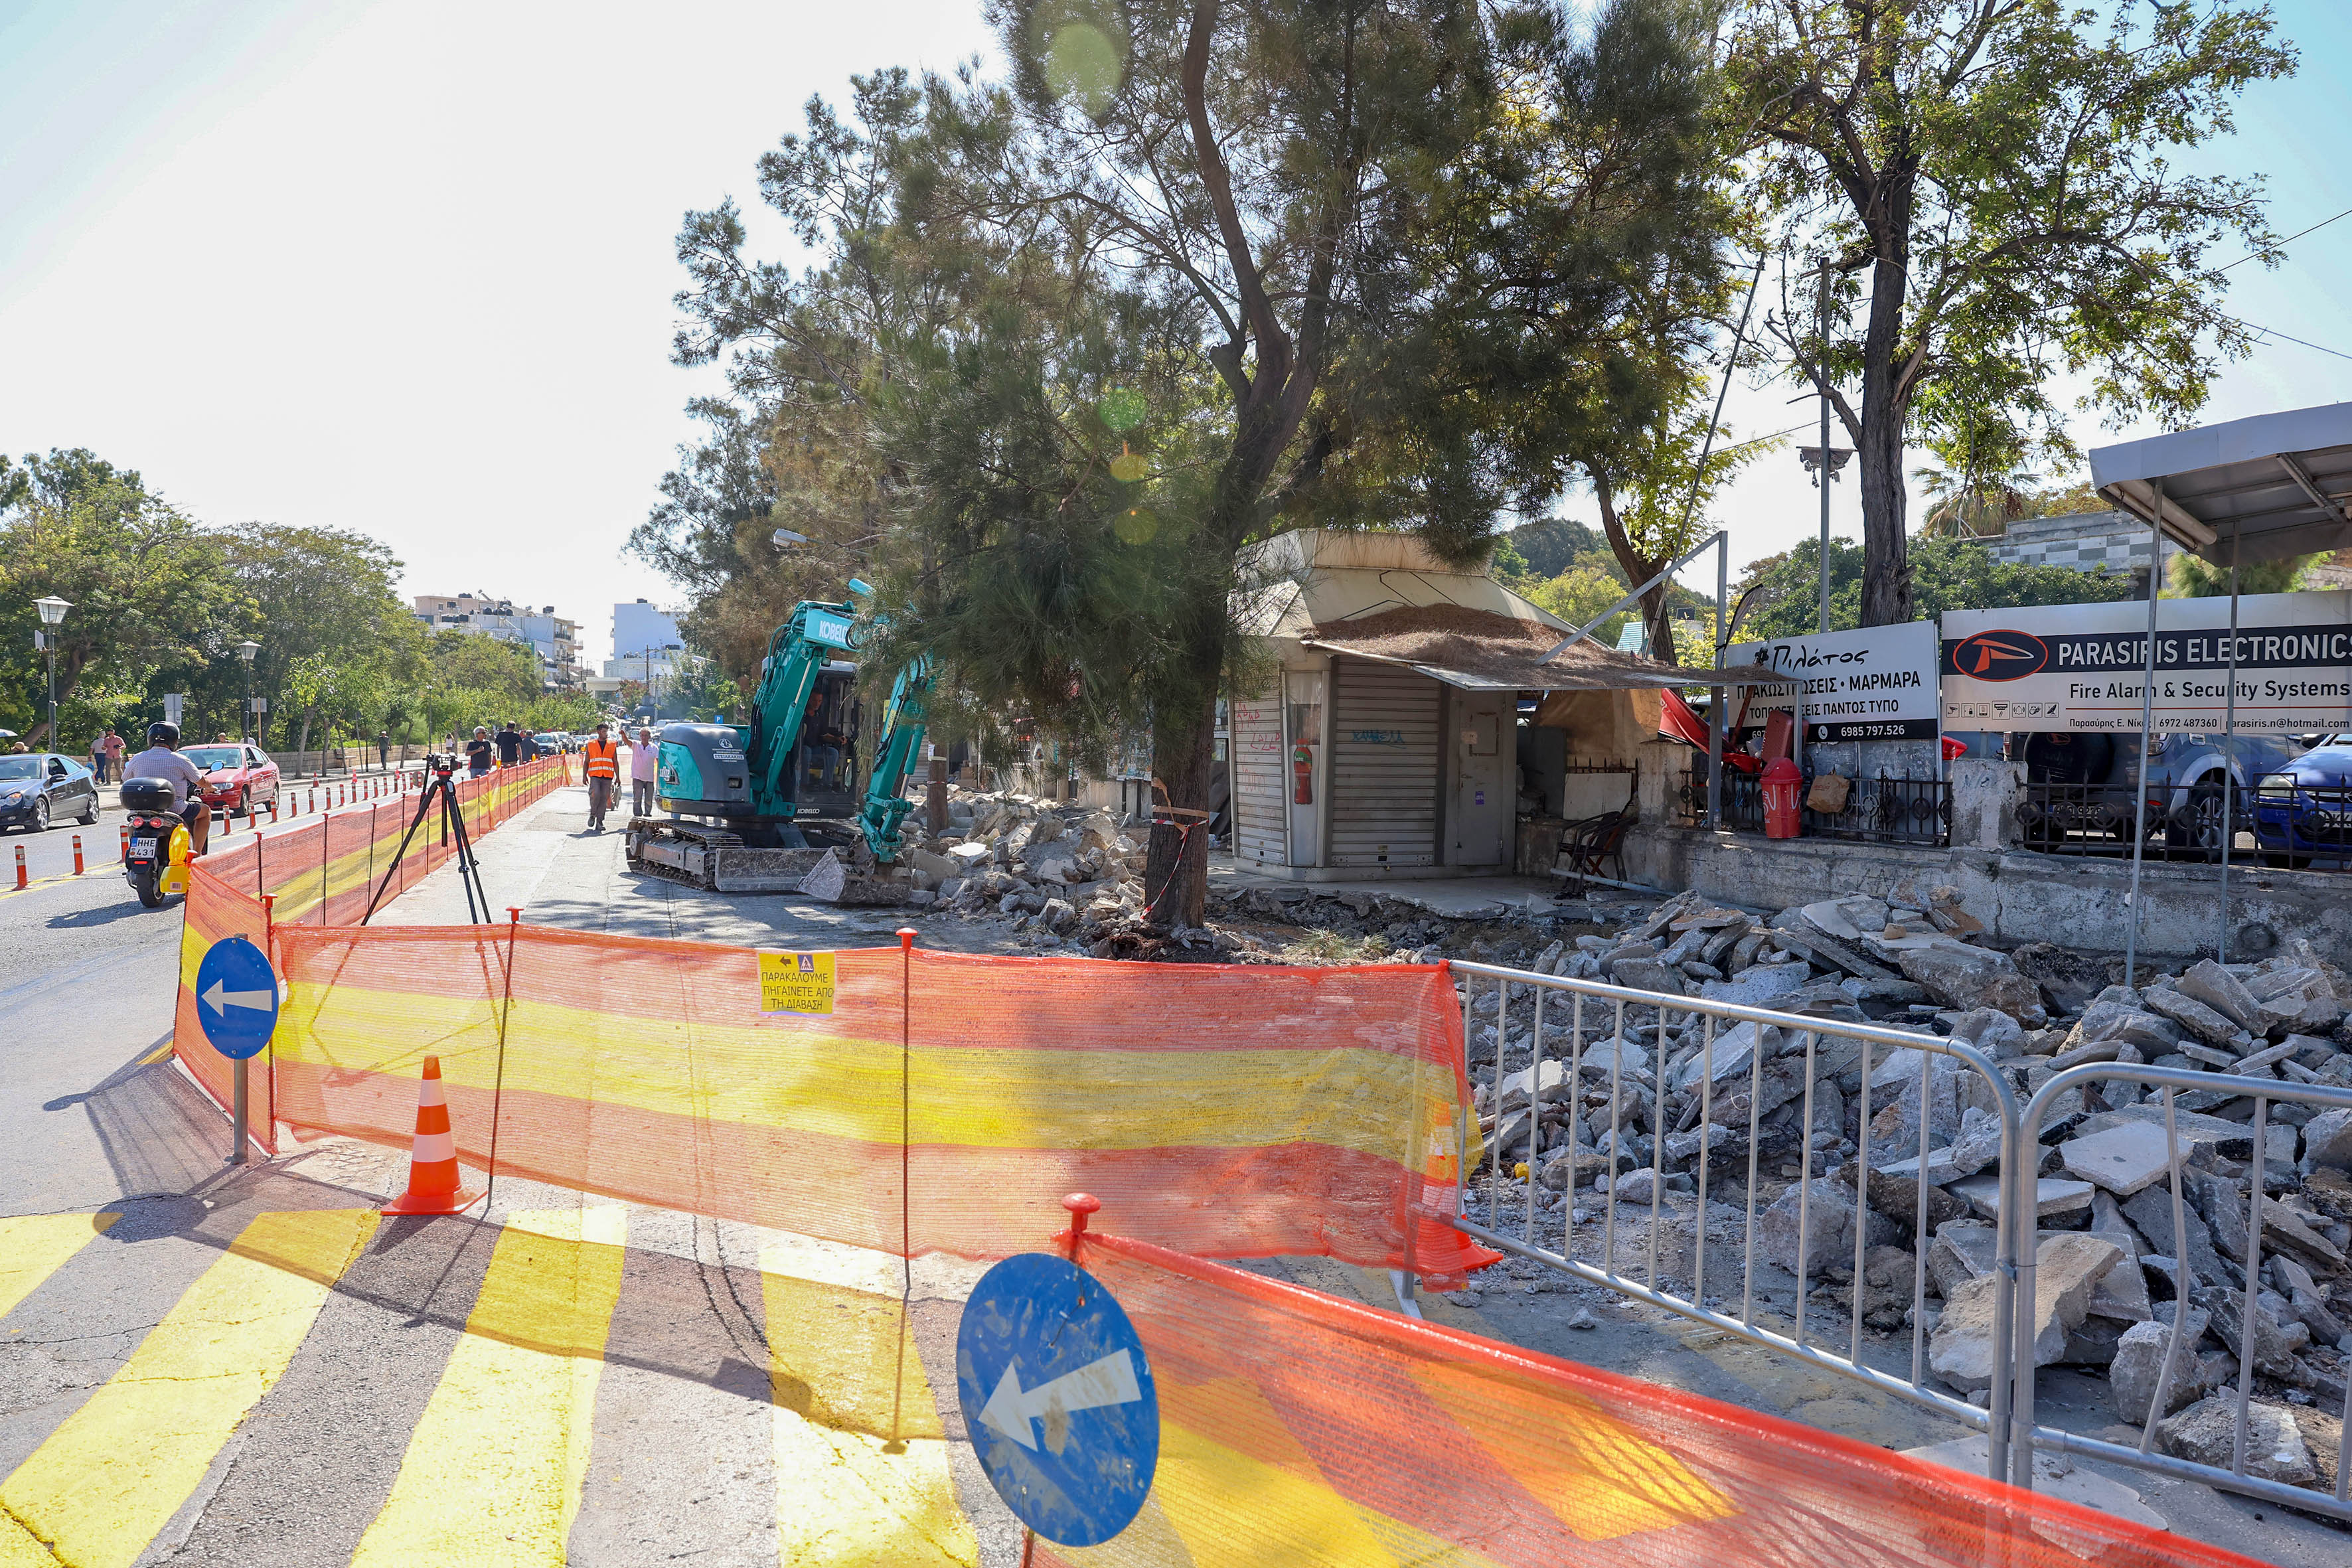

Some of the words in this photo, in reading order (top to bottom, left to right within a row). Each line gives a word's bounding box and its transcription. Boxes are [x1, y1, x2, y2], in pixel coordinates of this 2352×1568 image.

[819, 620, 850, 643] KOBELC
[2187, 633, 2352, 663] ELECTRONIC
[1772, 645, 1869, 673] Πιλάτος
[1849, 670, 1921, 691] ΜΑΡΜΑΡΑ
[2070, 683, 2101, 698] Fire
[2164, 682, 2176, 698] &
[2182, 681, 2258, 701] Secuity
[2264, 680, 2351, 701] Systems
[1824, 701, 1866, 715] ΠΑΝΤΟΣ
[1869, 699, 1899, 713] ΤΥΠΟ
[1841, 726, 1864, 737] 6985
[1866, 725, 1905, 736] 797.526
[2070, 718, 2114, 728] Παρασύρης
[2128, 718, 2152, 728] Νίκ
[2159, 718, 2181, 728] 6972
[2183, 718, 2217, 728] 487360
[761, 972, 828, 983] ΠΑΡΑΚΑΛΟΥΜΕ
[763, 985, 813, 997] ΠΗΓΑΙΝΕΤΕ
[816, 987, 834, 998] ΑΠΟ
[771, 998, 783, 1008] ΤΗ
[787, 998, 823, 1010] ΔΙΑΒΑΣΗ
